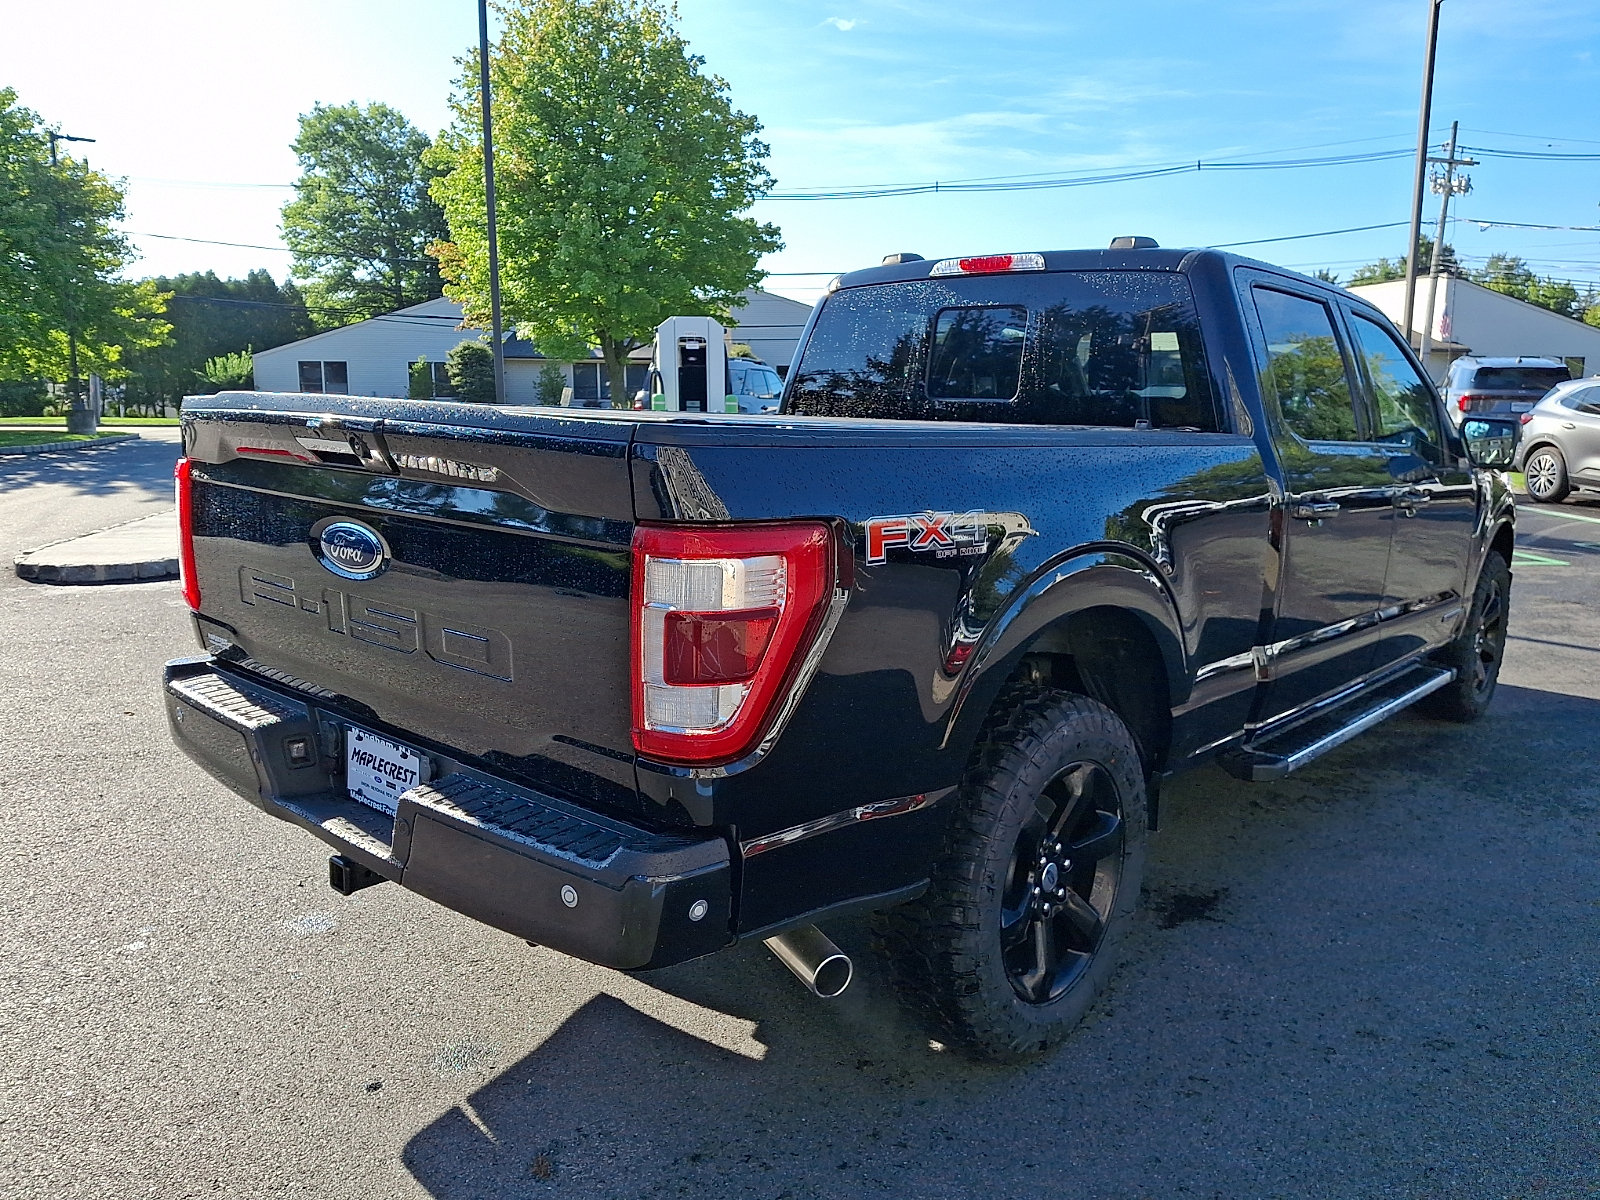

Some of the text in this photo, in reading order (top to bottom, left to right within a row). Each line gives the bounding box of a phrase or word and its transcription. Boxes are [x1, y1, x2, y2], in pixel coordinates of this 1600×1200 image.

[330, 532, 364, 562] Ford
[866, 509, 988, 566] FX4
[936, 550, 957, 558] OFF
[238, 565, 513, 682] F-150
[351, 747, 417, 785] MAPLECREST
